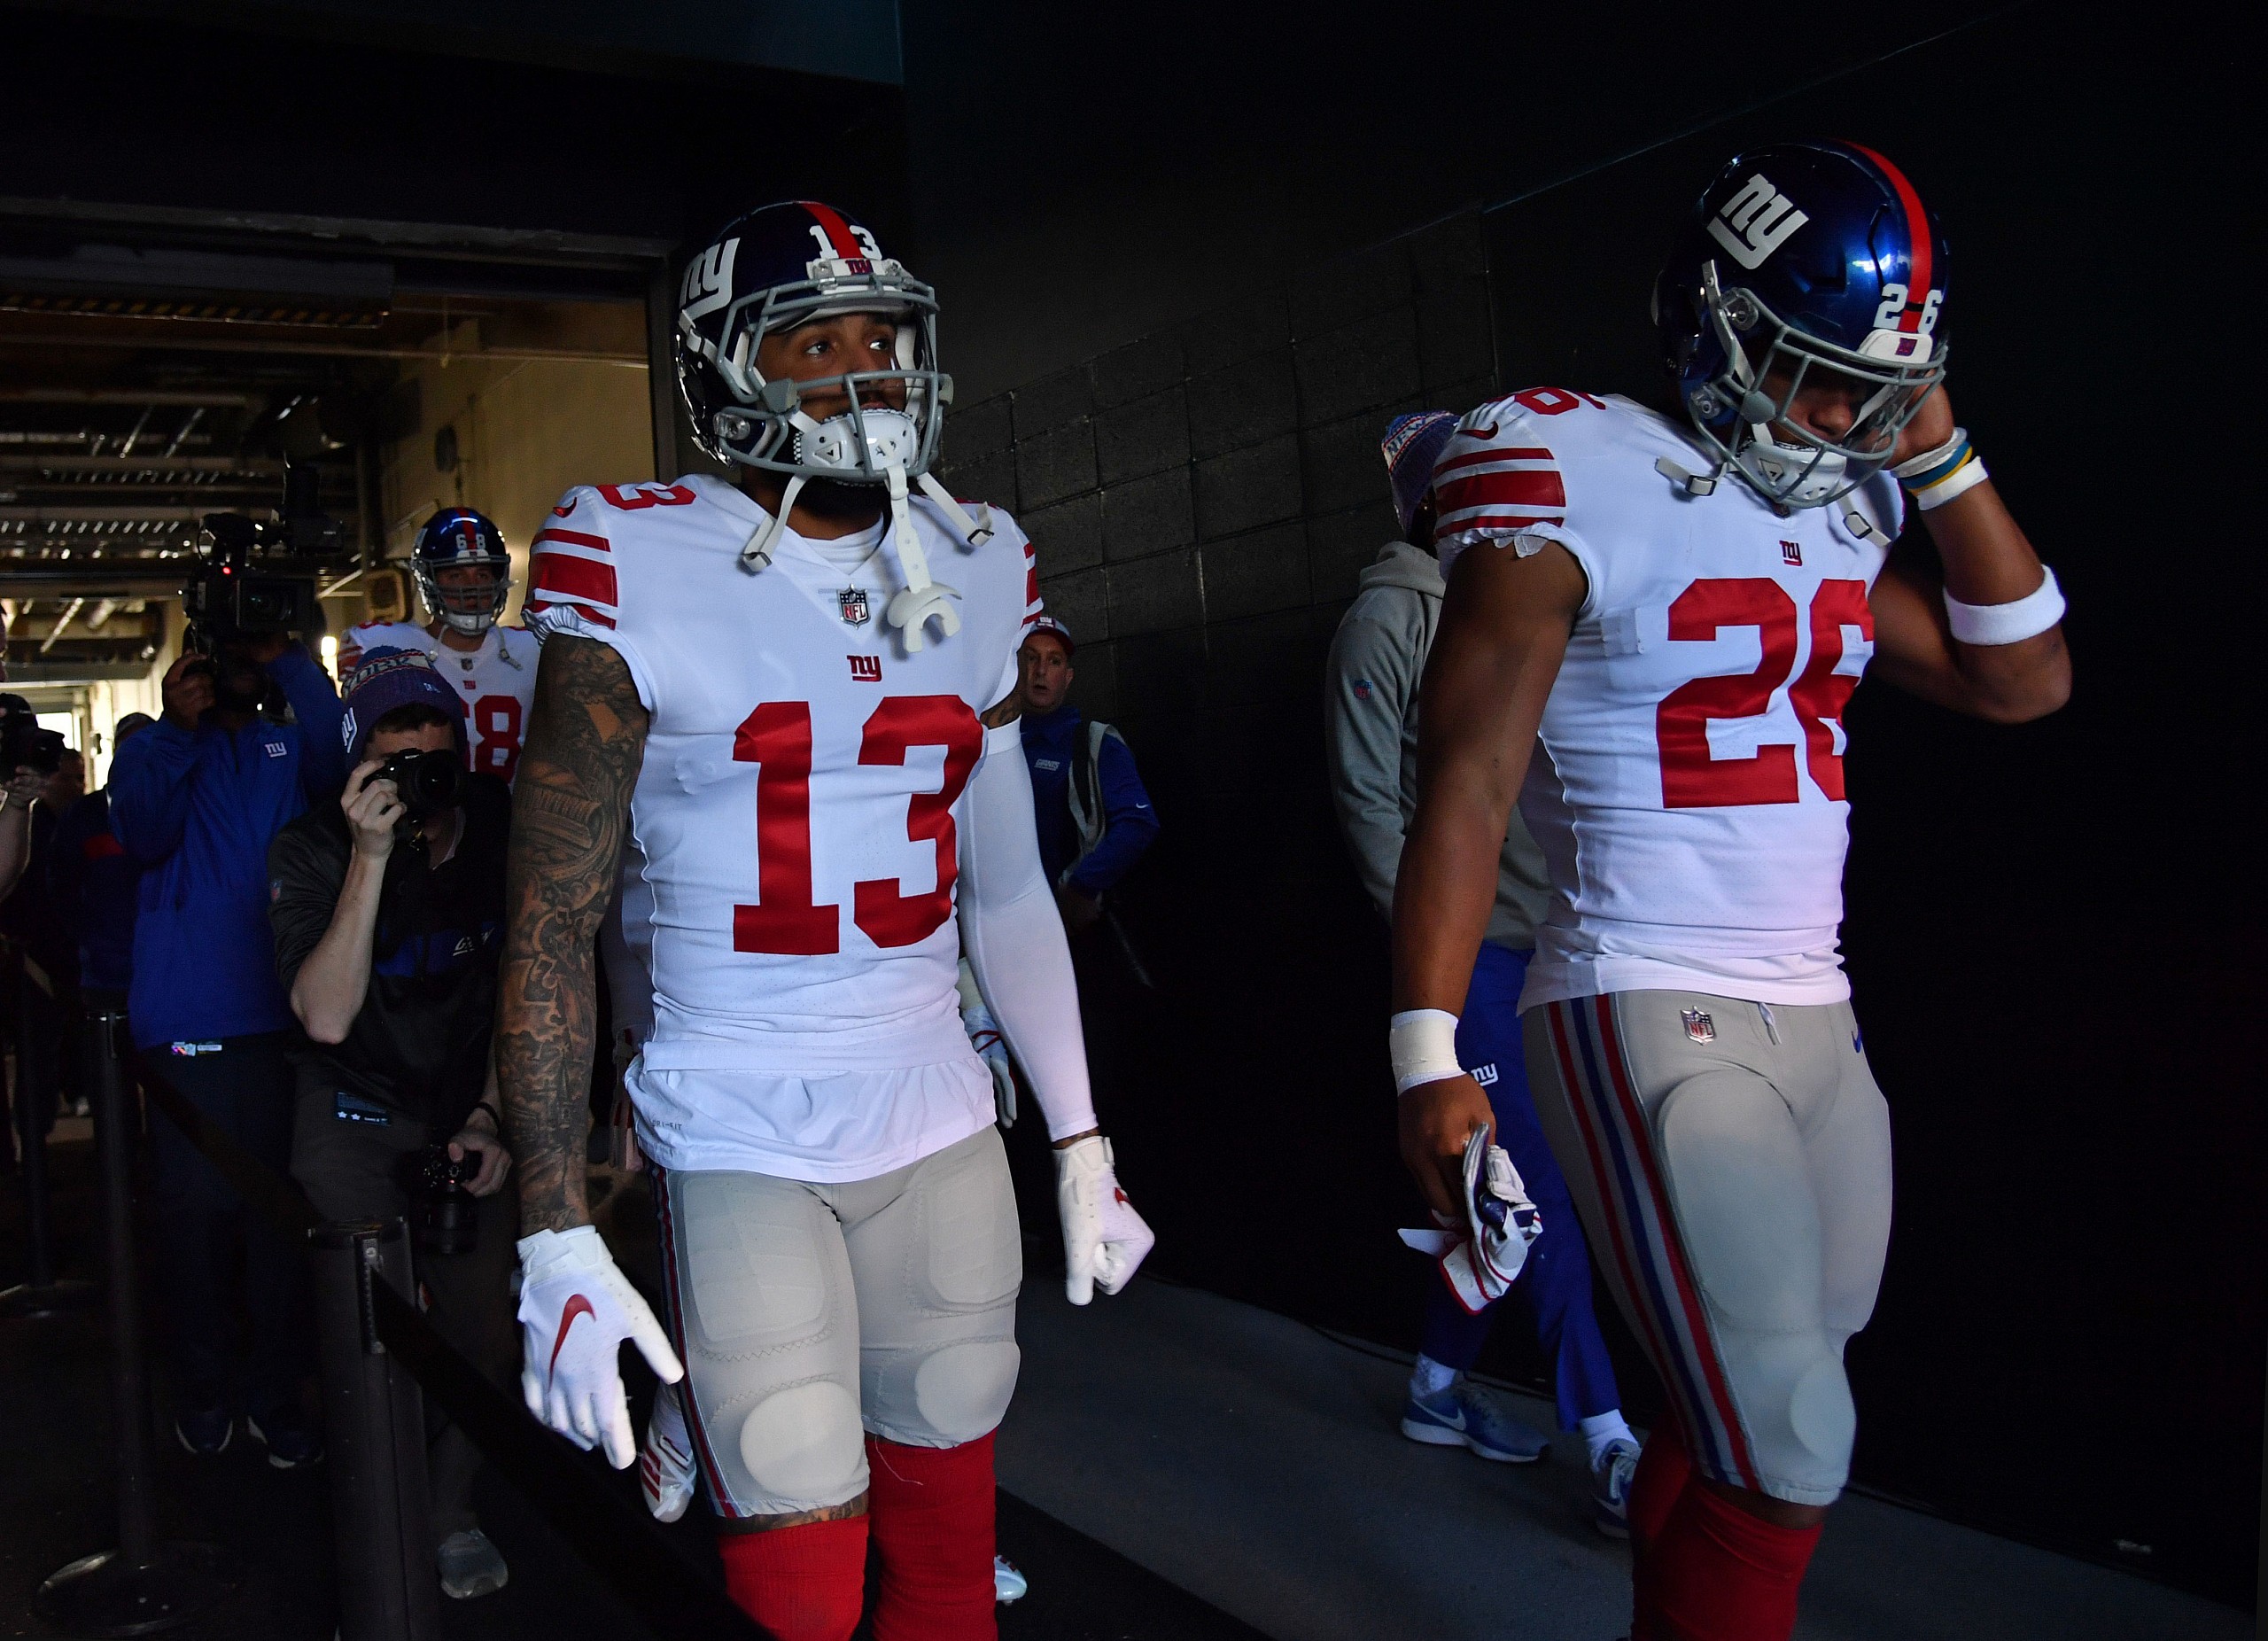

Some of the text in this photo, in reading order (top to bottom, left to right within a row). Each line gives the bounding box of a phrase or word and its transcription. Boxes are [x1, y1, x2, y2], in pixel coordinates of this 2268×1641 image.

[809, 224, 883, 261] 13
[1706, 173, 1809, 269] ny
[1873, 283, 1944, 335] 26
[843, 603, 866, 621] NFL
[1657, 577, 1876, 809] 26
[733, 695, 983, 955] 13
